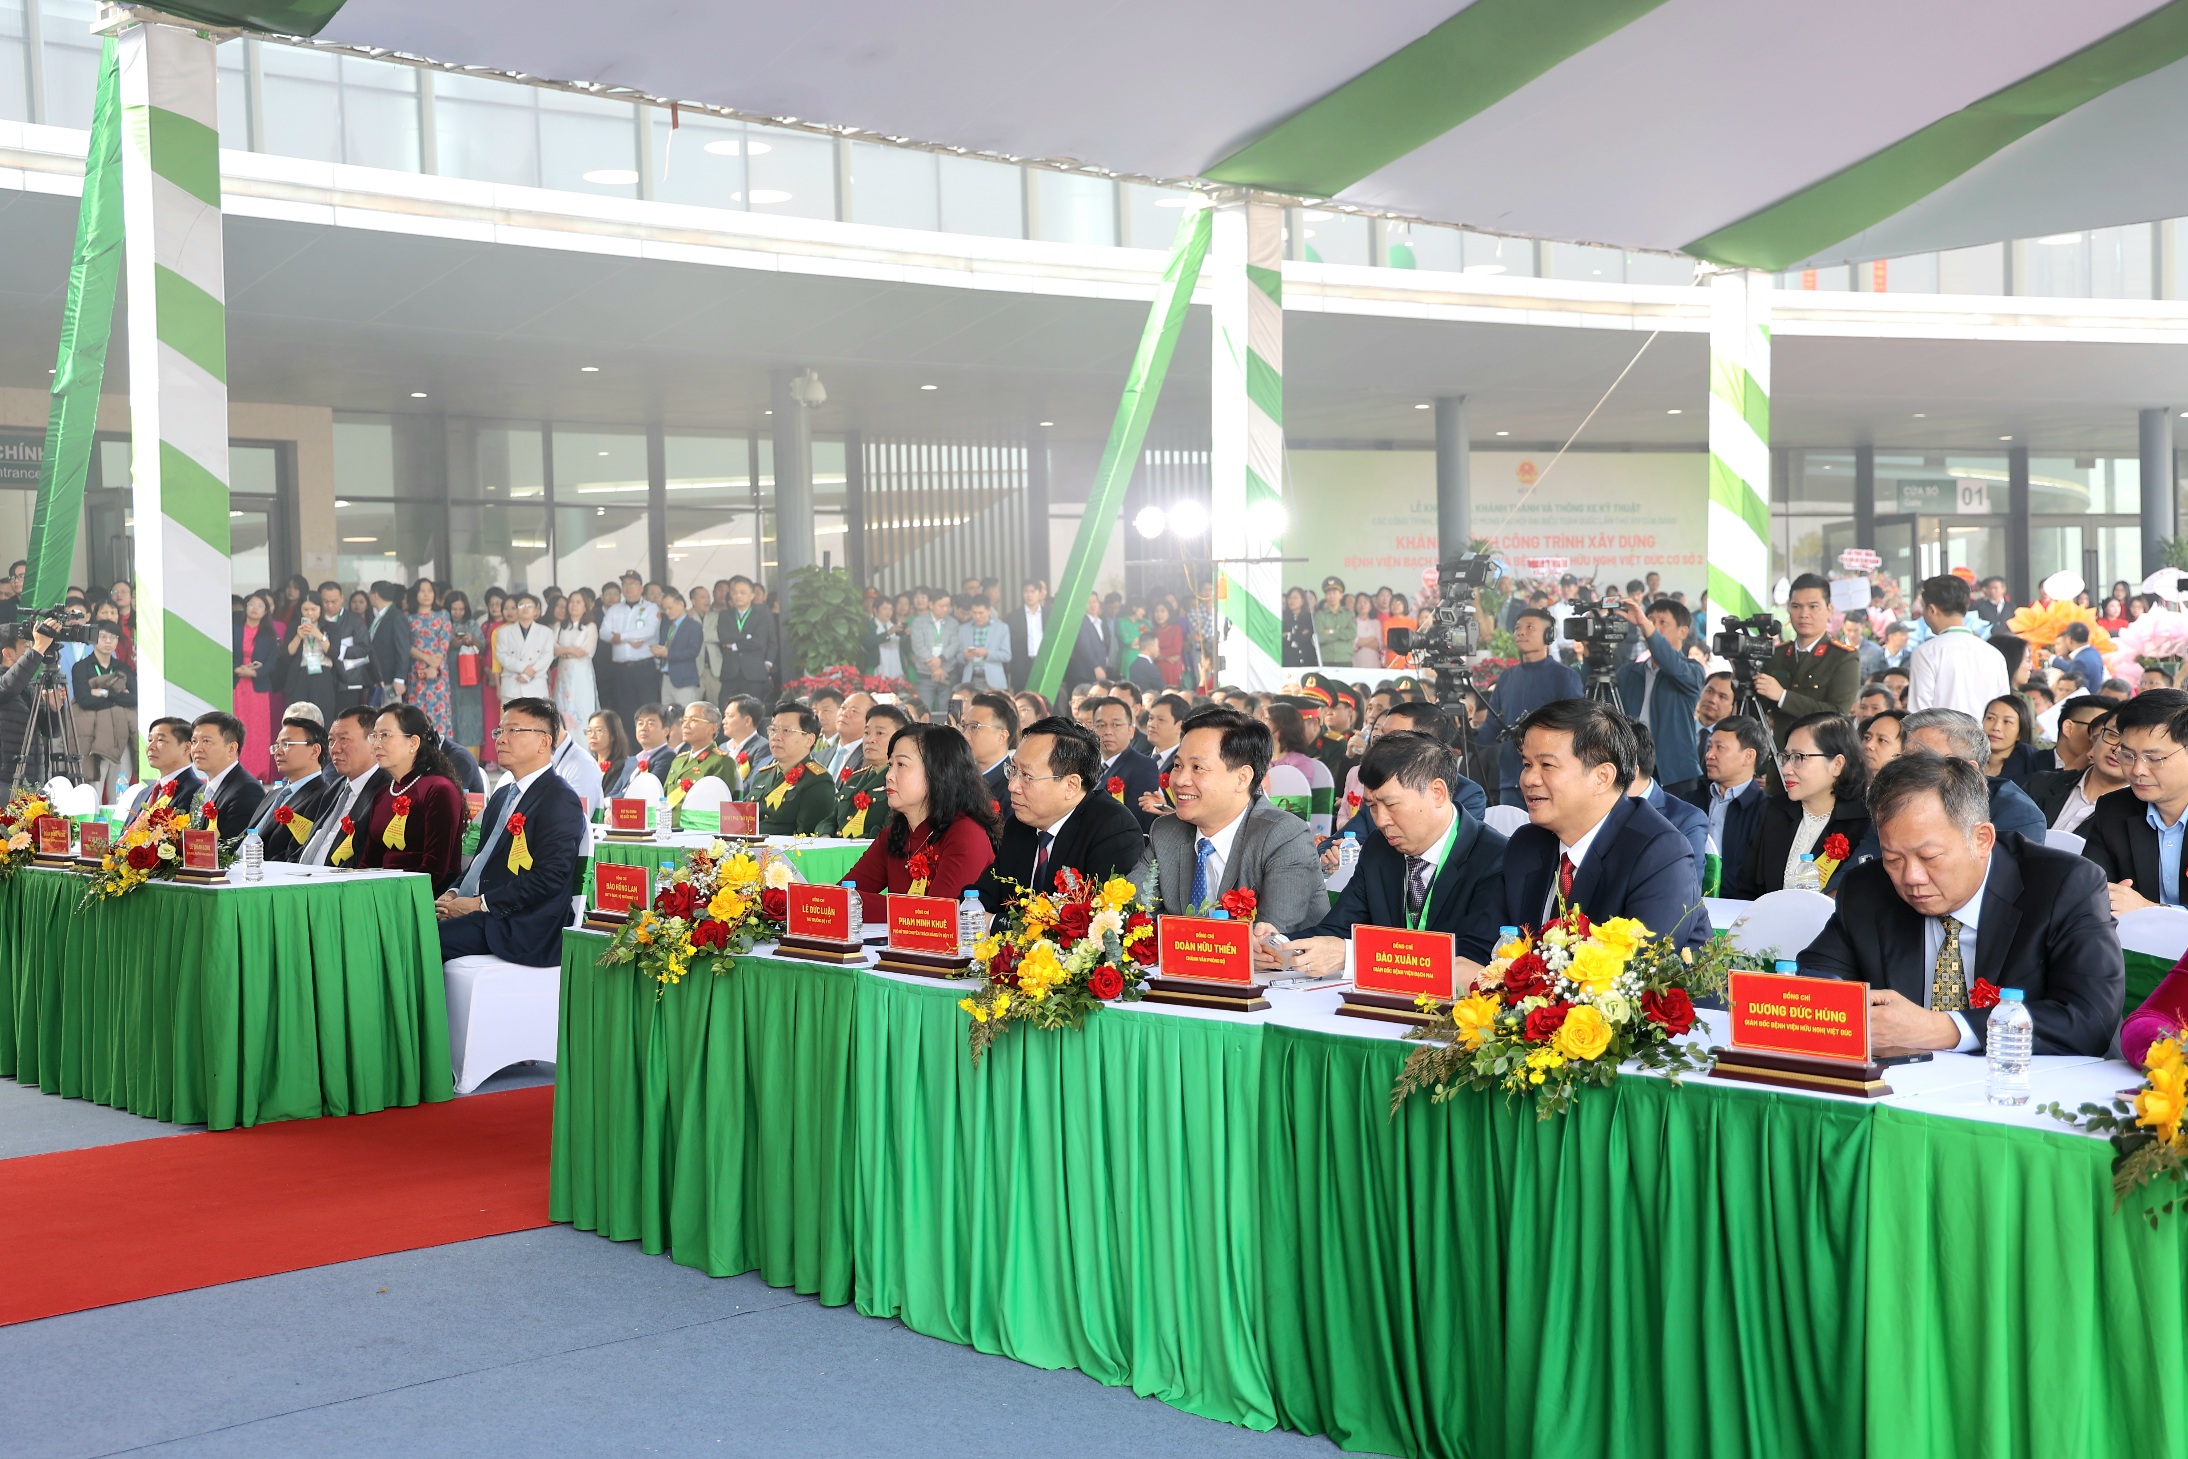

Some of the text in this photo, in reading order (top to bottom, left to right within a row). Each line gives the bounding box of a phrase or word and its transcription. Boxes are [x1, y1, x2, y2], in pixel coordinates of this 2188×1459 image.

[0, 442, 43, 461] HÍN
[1962, 486, 1983, 506] 01
[1396, 532, 1438, 550] KHÁN
[1502, 532, 1540, 549] CÔNG
[1543, 532, 1583, 549] TRÌNH
[1588, 532, 1615, 549] XÂY
[1619, 534, 1656, 552] DỰNG
[1344, 555, 1374, 570] BỆNH
[1375, 555, 1401, 570] VIỆN
[1403, 556, 1433, 570] BẠCH
[1697, 554, 1704, 565] 2
[606, 882, 615, 890] ĐÀO
[802, 903, 836, 917] LÊ ĐỨC LUẬN
[898, 917, 947, 929] PHẠM MINH KHUÊ
[1174, 940, 1237, 954] ĐOÀN HỮU THIỂN
[1375, 951, 1431, 967] ĐÀO XUÂN CƠ
[1383, 966, 1392, 974] ĐỐC
[1393, 968, 1403, 976] BỆNH
[1403, 969, 1414, 977] VIỆN
[1782, 991, 1811, 1002] ĐỒNG CHÍ
[1749, 1002, 1847, 1023] DƯƠNG ĐỨC HÙNG
[1744, 1018, 1853, 1037] GIÁM ĐỐC BỆNH VIỆN HỮU NGHỊ VIỆT ĐỨC
